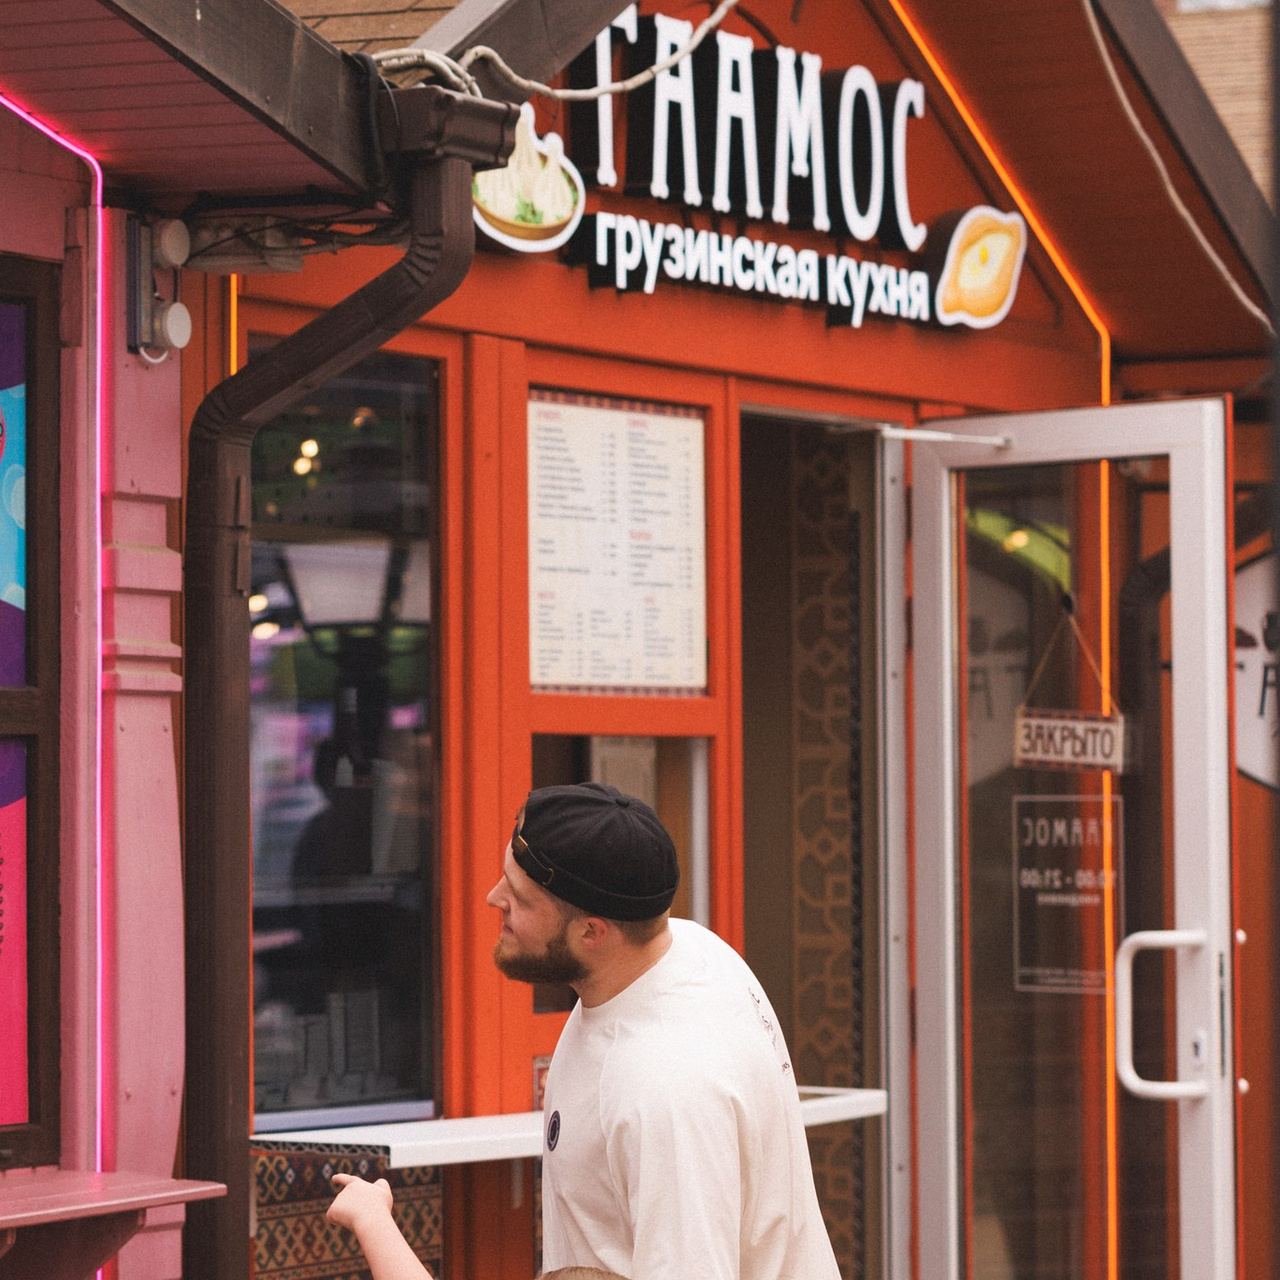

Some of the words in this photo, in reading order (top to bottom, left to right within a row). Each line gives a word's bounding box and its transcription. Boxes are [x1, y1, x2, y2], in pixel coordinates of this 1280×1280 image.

[595, 3, 927, 251] ГААМОС
[595, 211, 820, 302] грузинская
[827, 254, 930, 328] кухня
[1021, 724, 1114, 758] ЗАКРЫТО
